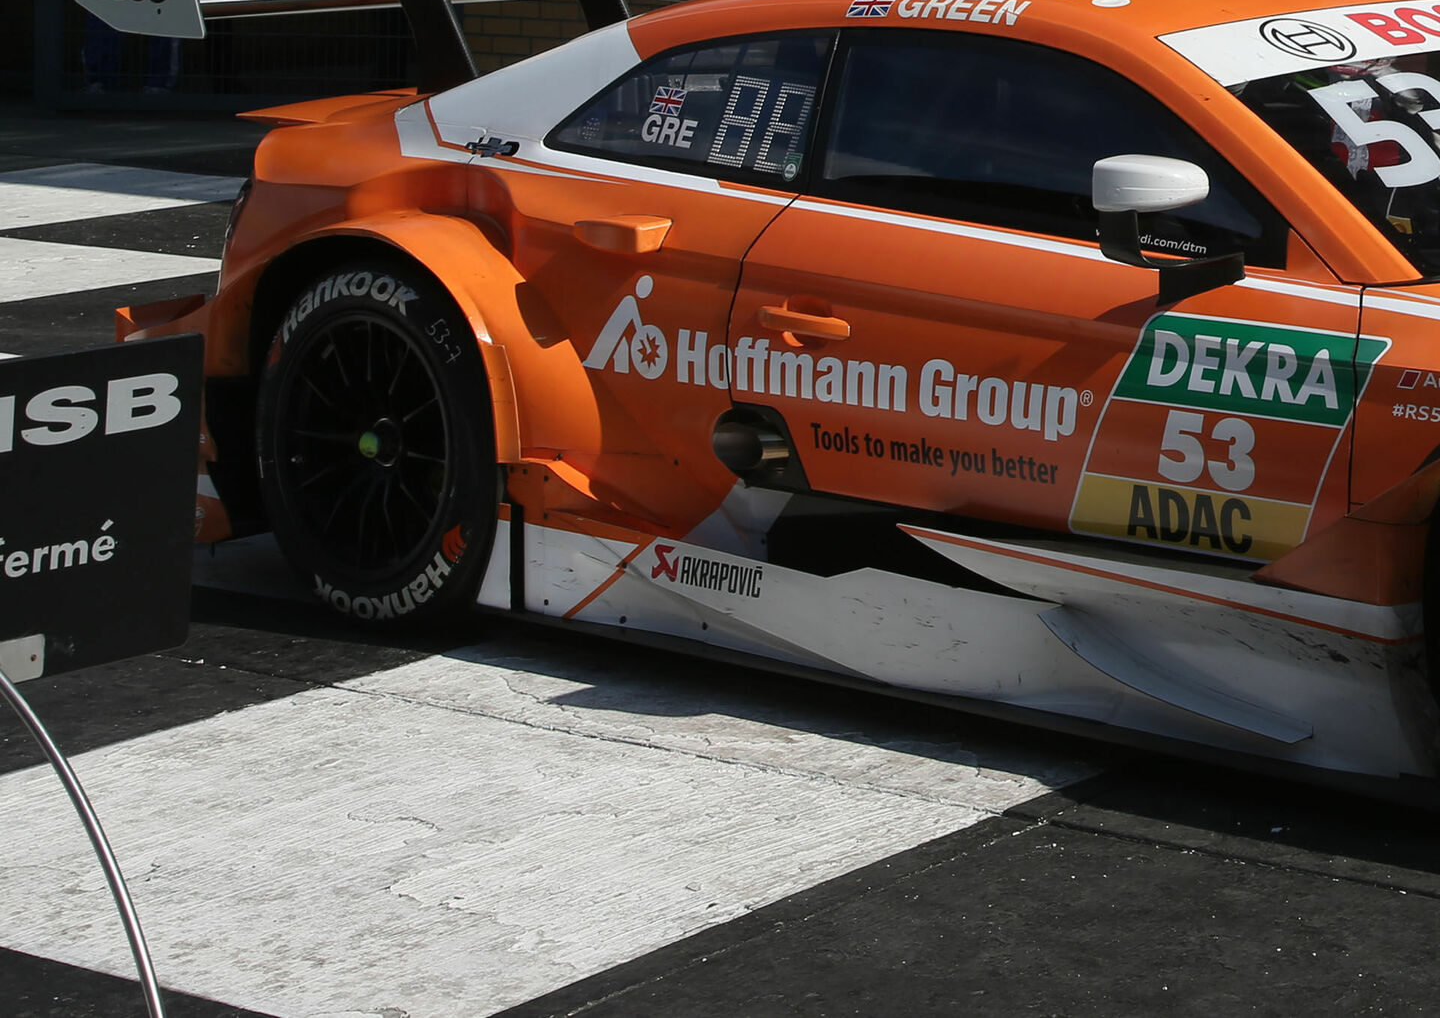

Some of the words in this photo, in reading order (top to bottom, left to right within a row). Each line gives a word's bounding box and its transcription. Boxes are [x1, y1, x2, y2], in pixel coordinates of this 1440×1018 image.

[641, 114, 698, 150] GRE
[282, 270, 418, 343] Hankook
[423, 318, 463, 364] 53-7
[677, 329, 908, 413] Hoffmann
[1146, 329, 1340, 410] DEKRA
[810, 423, 860, 455] Tools
[864, 433, 885, 458] to
[890, 437, 944, 468] make
[949, 448, 986, 476] you
[992, 447, 1059, 484] better
[1157, 410, 1257, 493] 53
[1127, 484, 1253, 555] ADAC
[313, 551, 451, 621] Hankook
